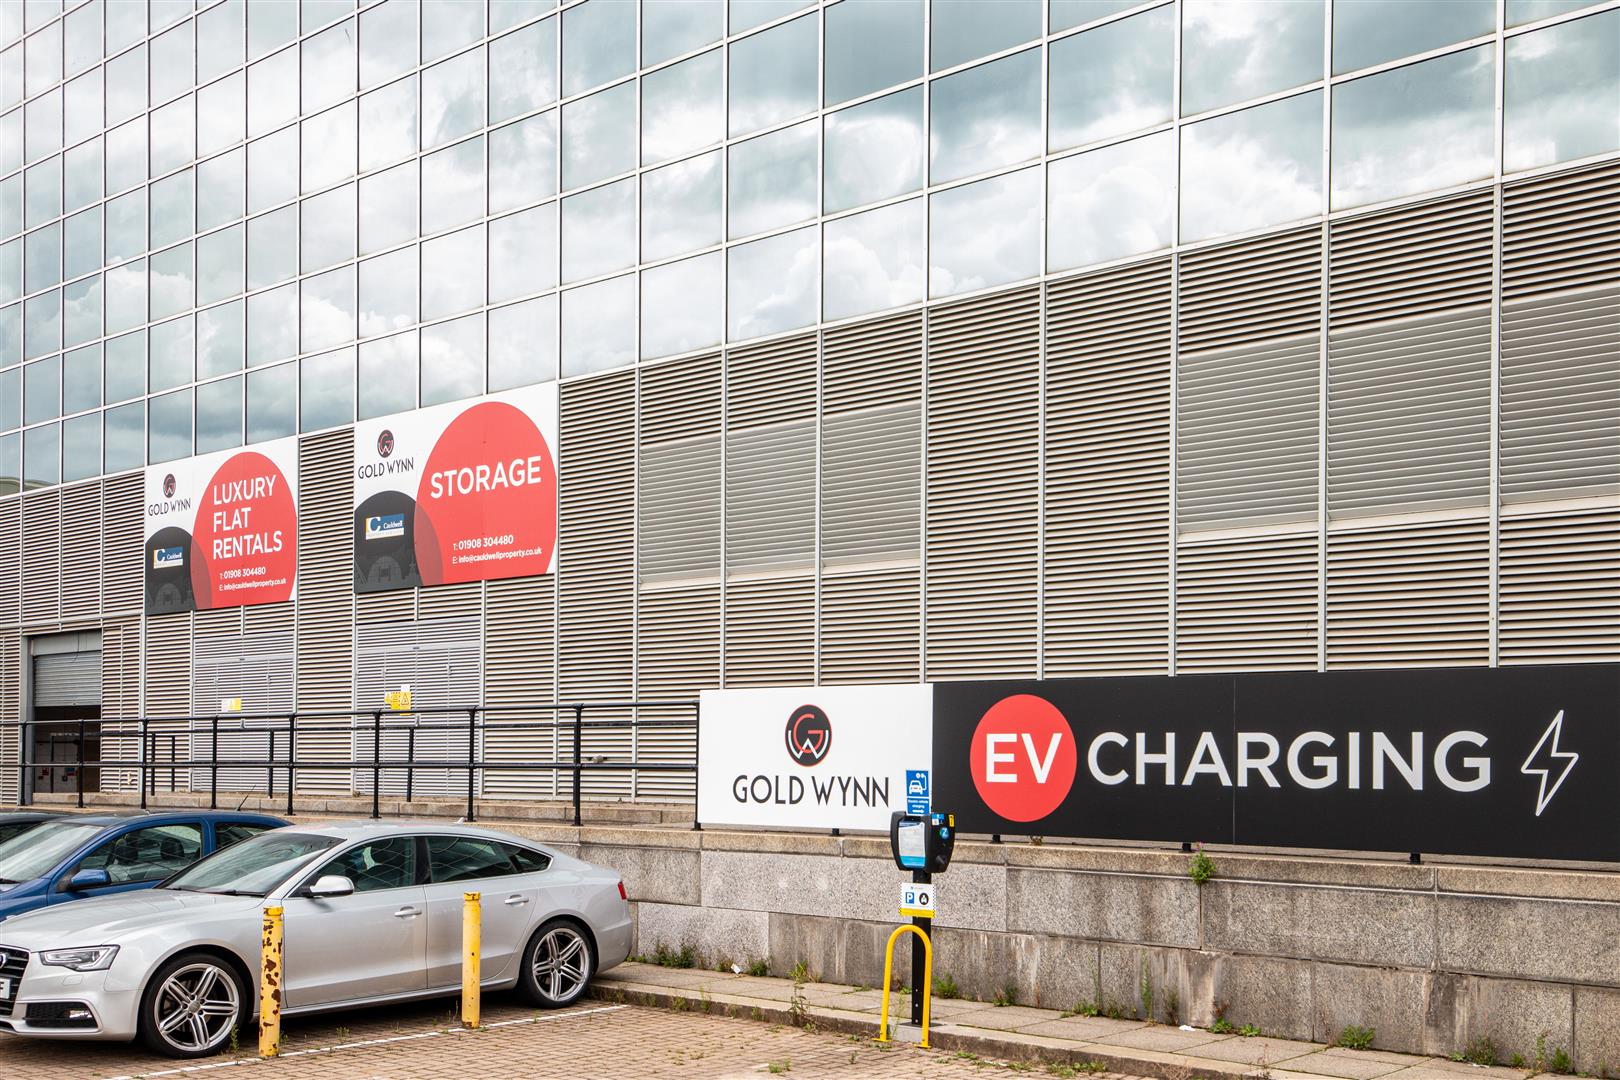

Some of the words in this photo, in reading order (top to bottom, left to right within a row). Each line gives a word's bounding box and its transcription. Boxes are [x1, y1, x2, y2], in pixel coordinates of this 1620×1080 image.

[358, 463, 385, 480] GOLD
[386, 457, 414, 475] WYNN
[430, 455, 542, 499] STORAGE
[213, 474, 276, 505] LUXURY
[148, 501, 169, 516] GOLD
[170, 498, 191, 512] WYNN
[213, 507, 252, 533] FLAT
[213, 530, 283, 560] RENTALS
[458, 538, 482, 550] 01908
[483, 534, 514, 548] 304480
[223, 569, 242, 580] 01908
[242, 566, 266, 577] 304480
[985, 731, 1063, 785] EV
[1087, 729, 1491, 793] CHARGING
[732, 774, 805, 806] GOLD
[811, 775, 890, 808] WYNN
